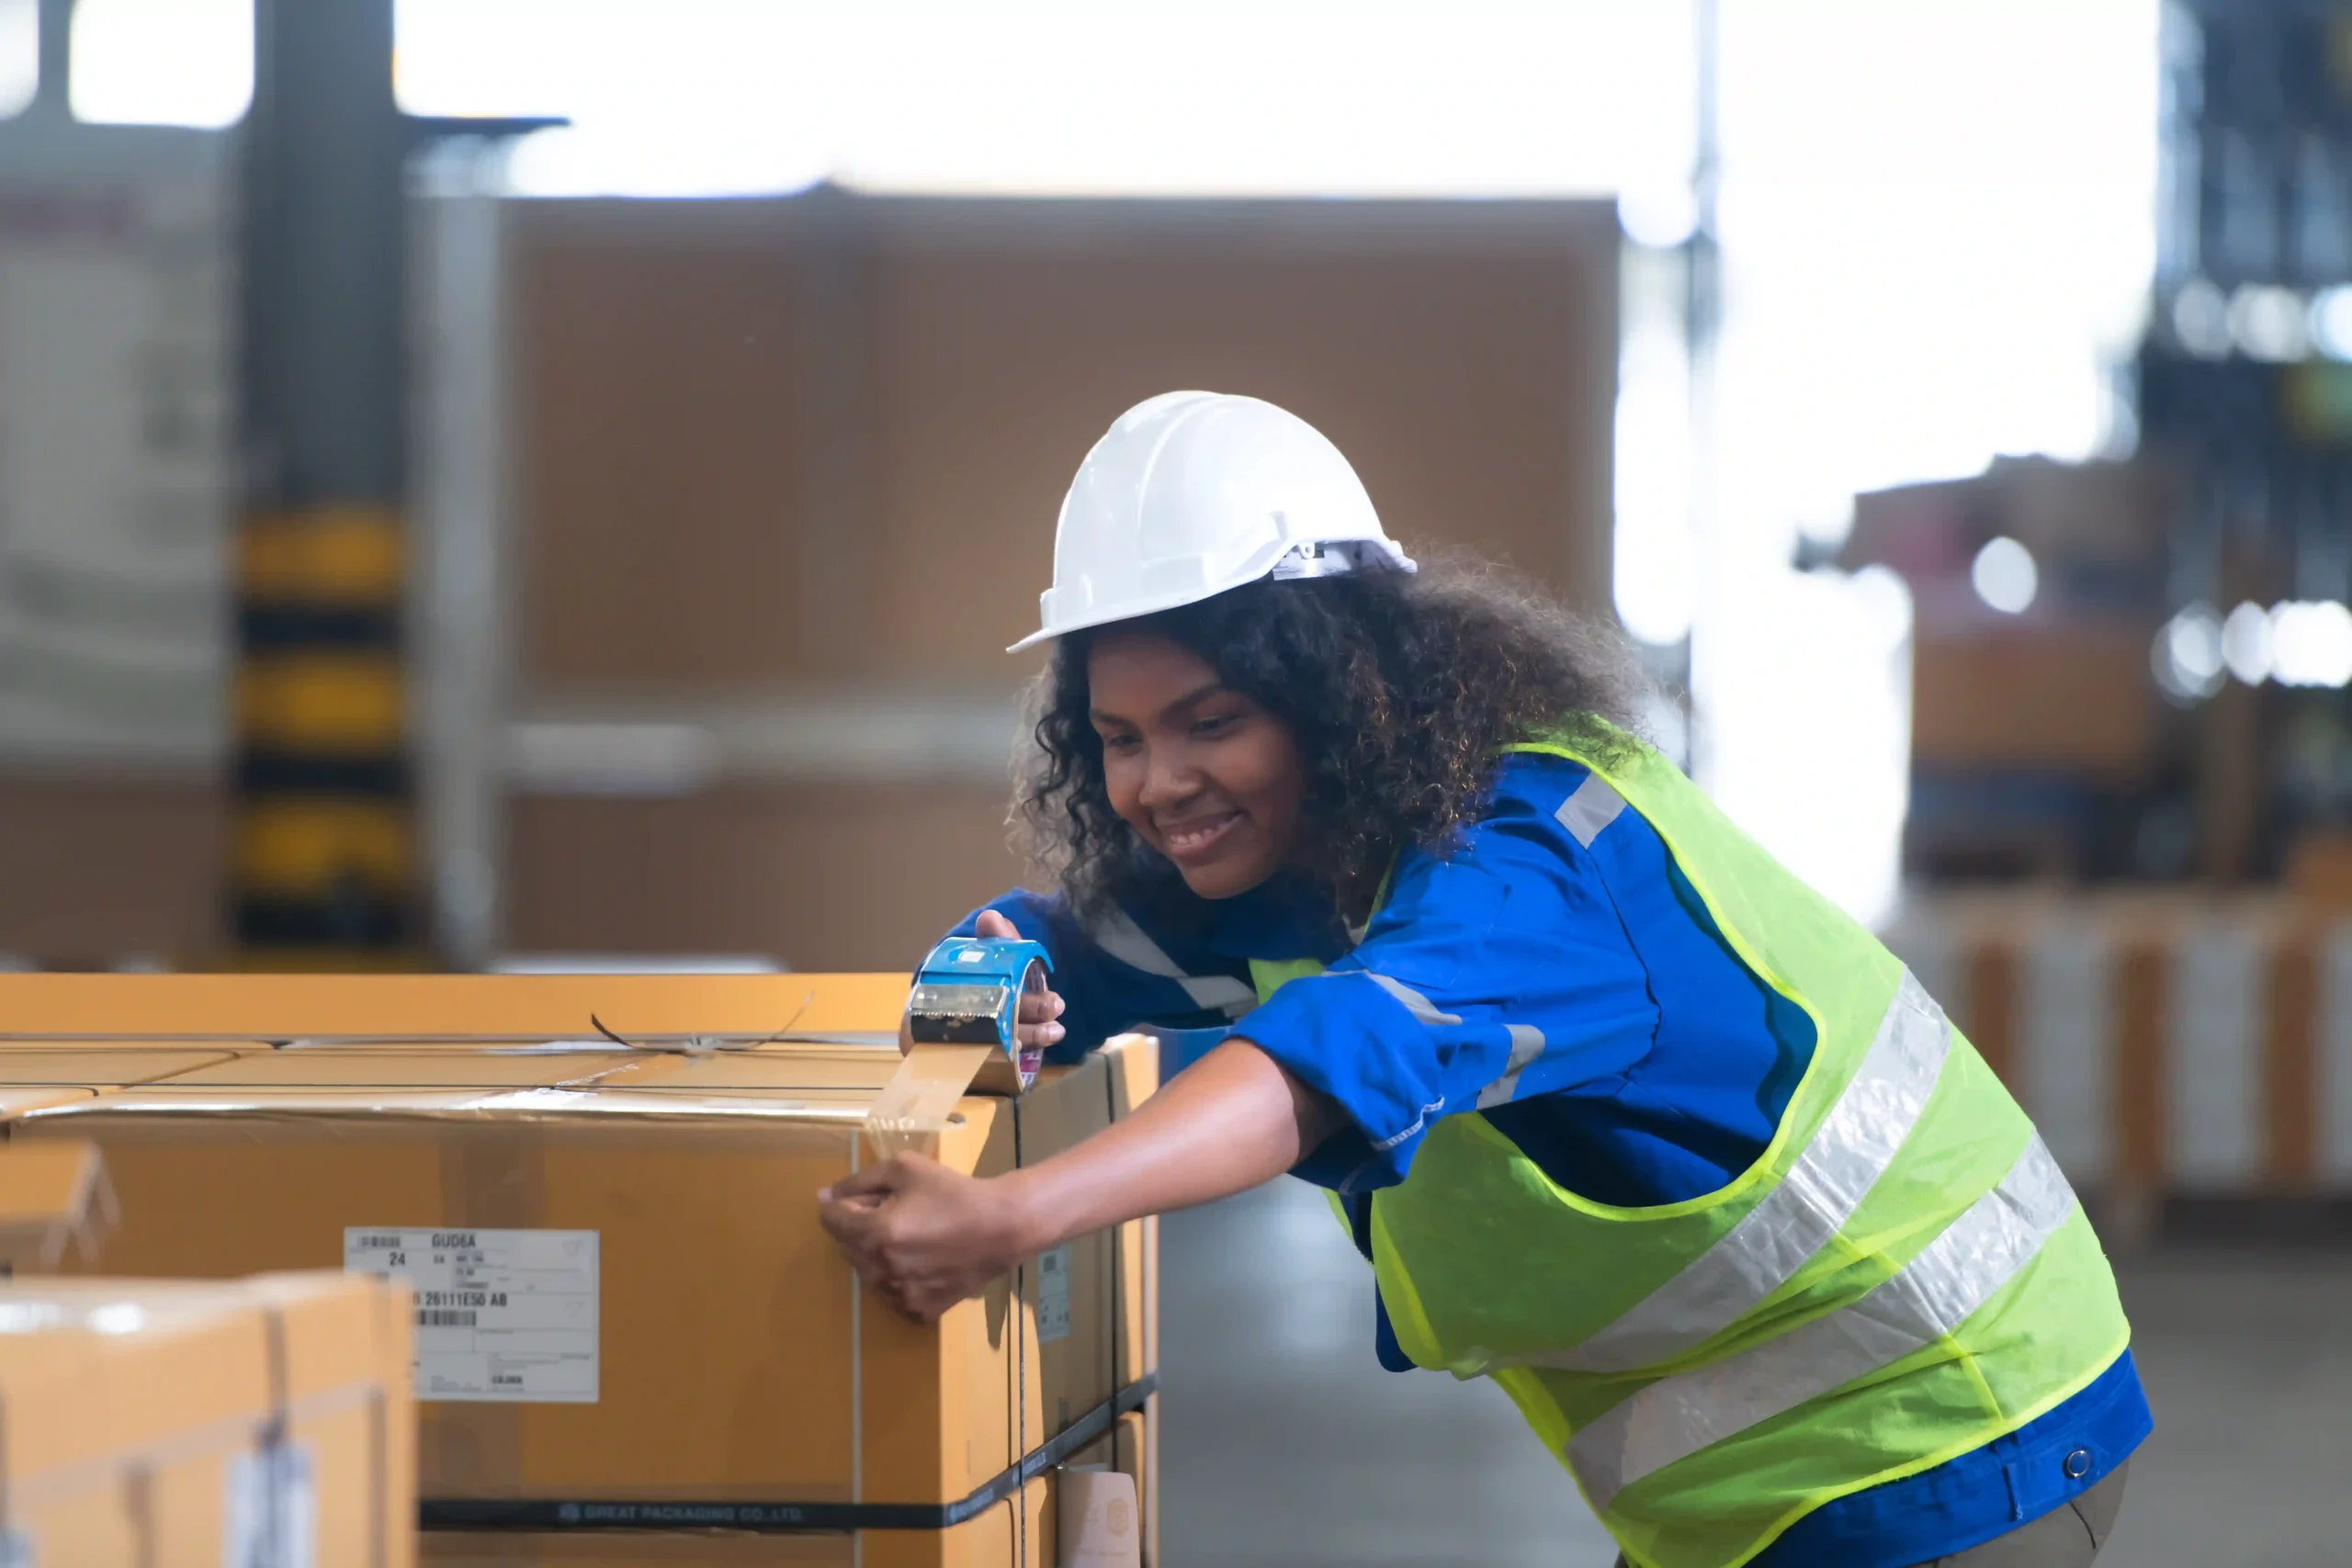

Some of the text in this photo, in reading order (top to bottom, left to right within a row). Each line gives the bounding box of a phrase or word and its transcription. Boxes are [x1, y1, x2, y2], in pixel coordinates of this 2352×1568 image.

[389, 1252, 406, 1267] 24
[584, 1506, 636, 1519] GREAT
[640, 1506, 734, 1520] PACKAGING
